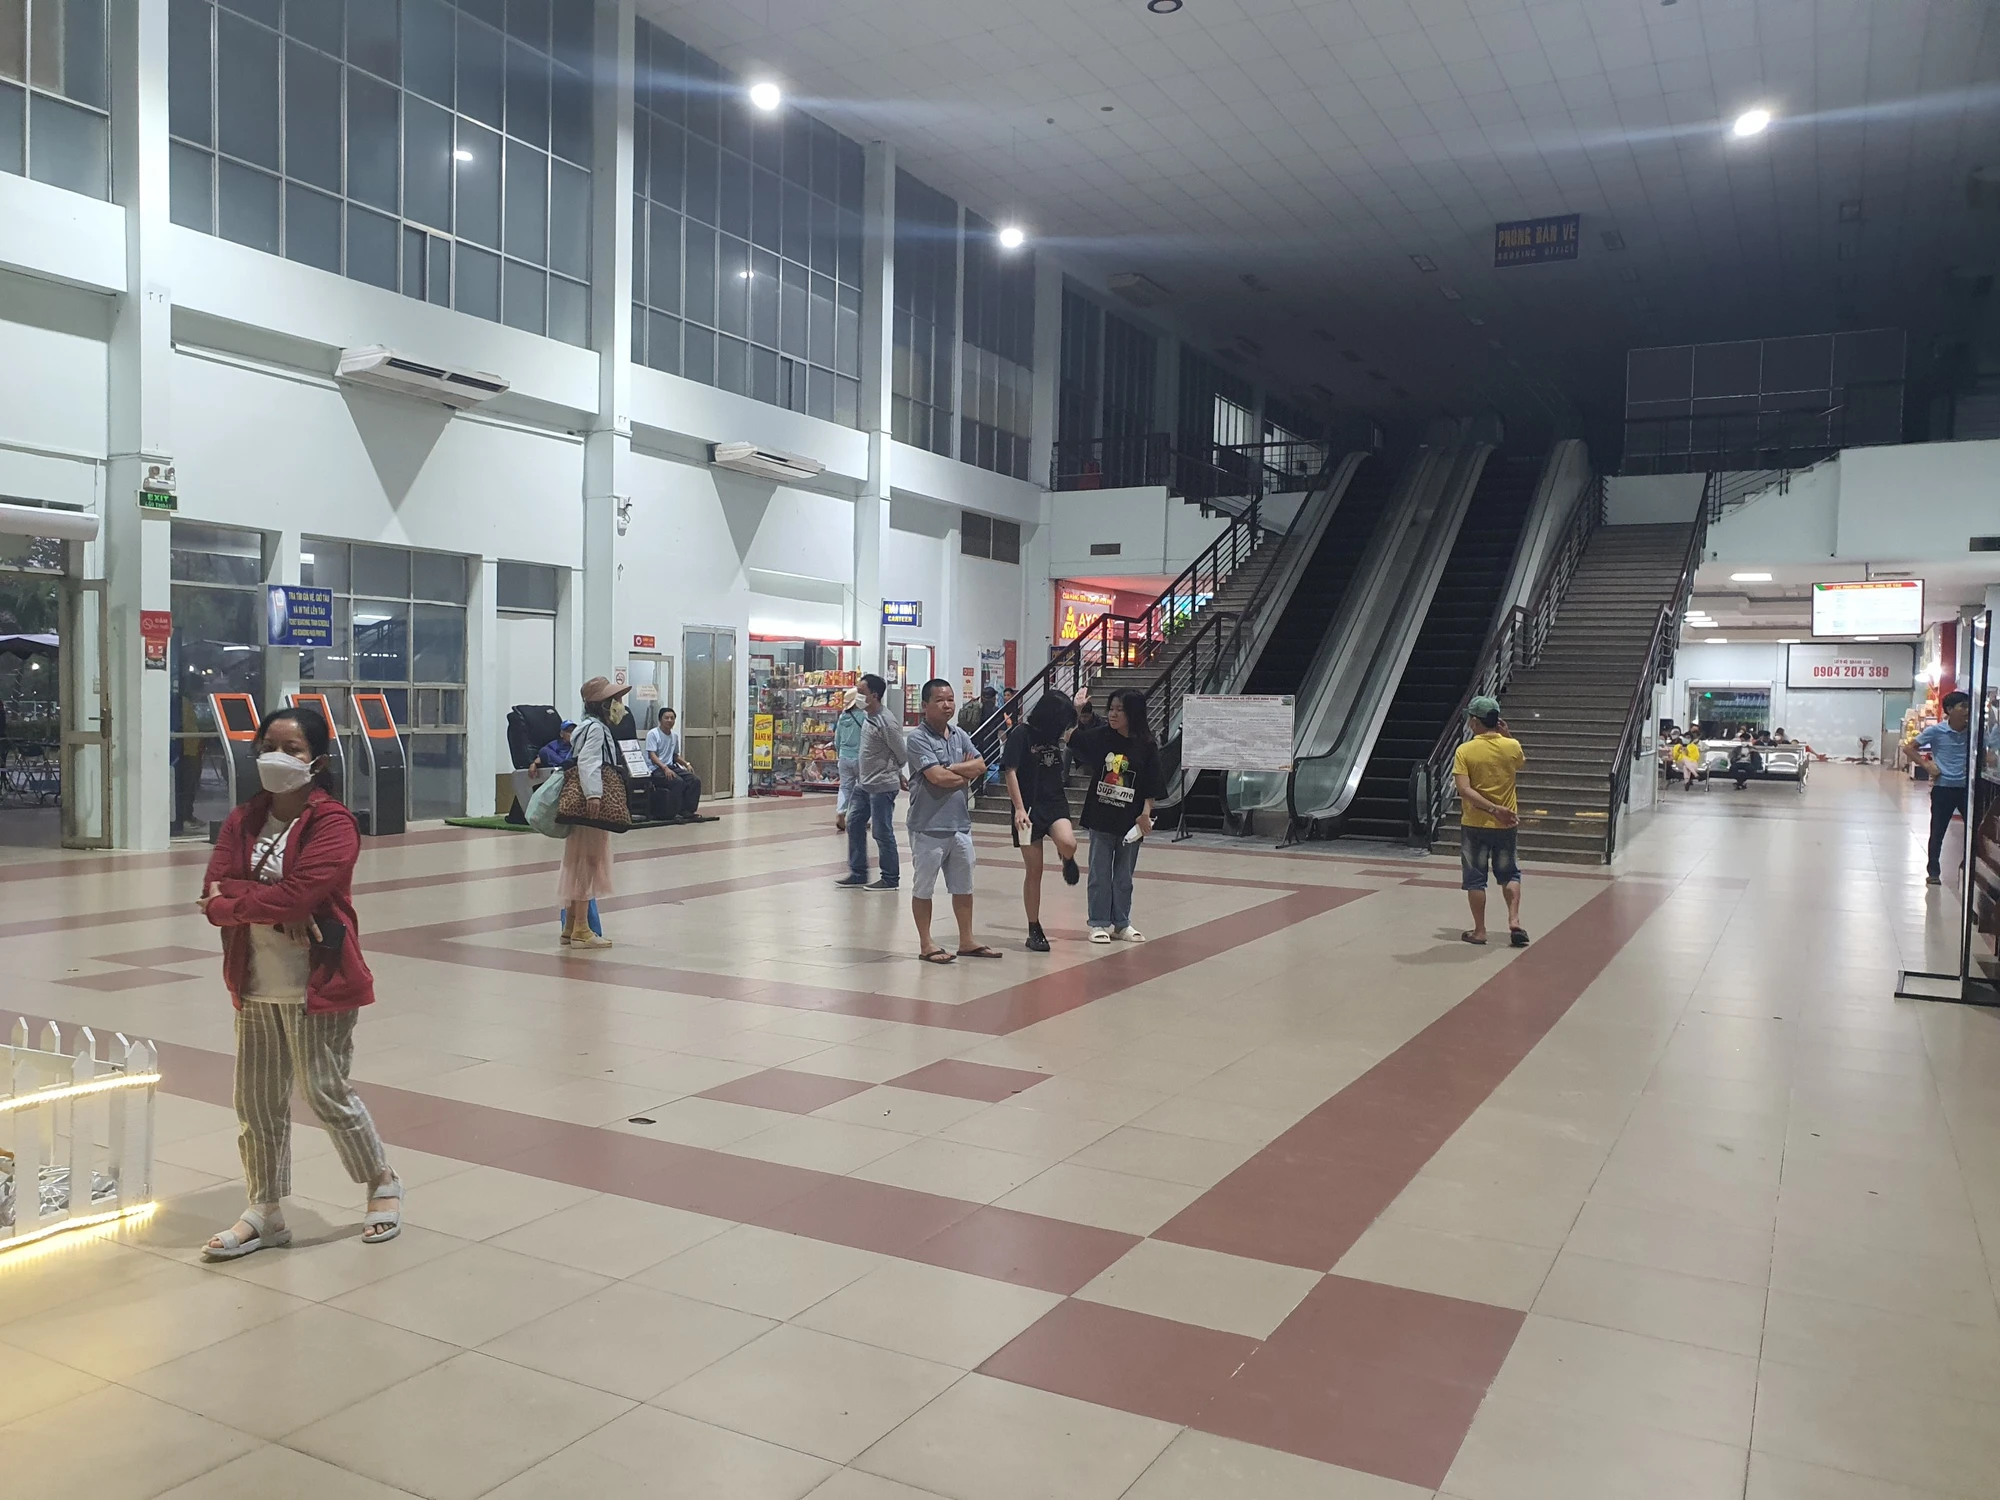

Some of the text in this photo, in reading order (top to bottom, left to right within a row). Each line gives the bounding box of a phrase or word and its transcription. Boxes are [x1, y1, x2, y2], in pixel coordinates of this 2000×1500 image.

[147, 493, 169, 502] EXIT
[1813, 666, 1840, 677] 0904
[1844, 666, 1864, 677] 204
